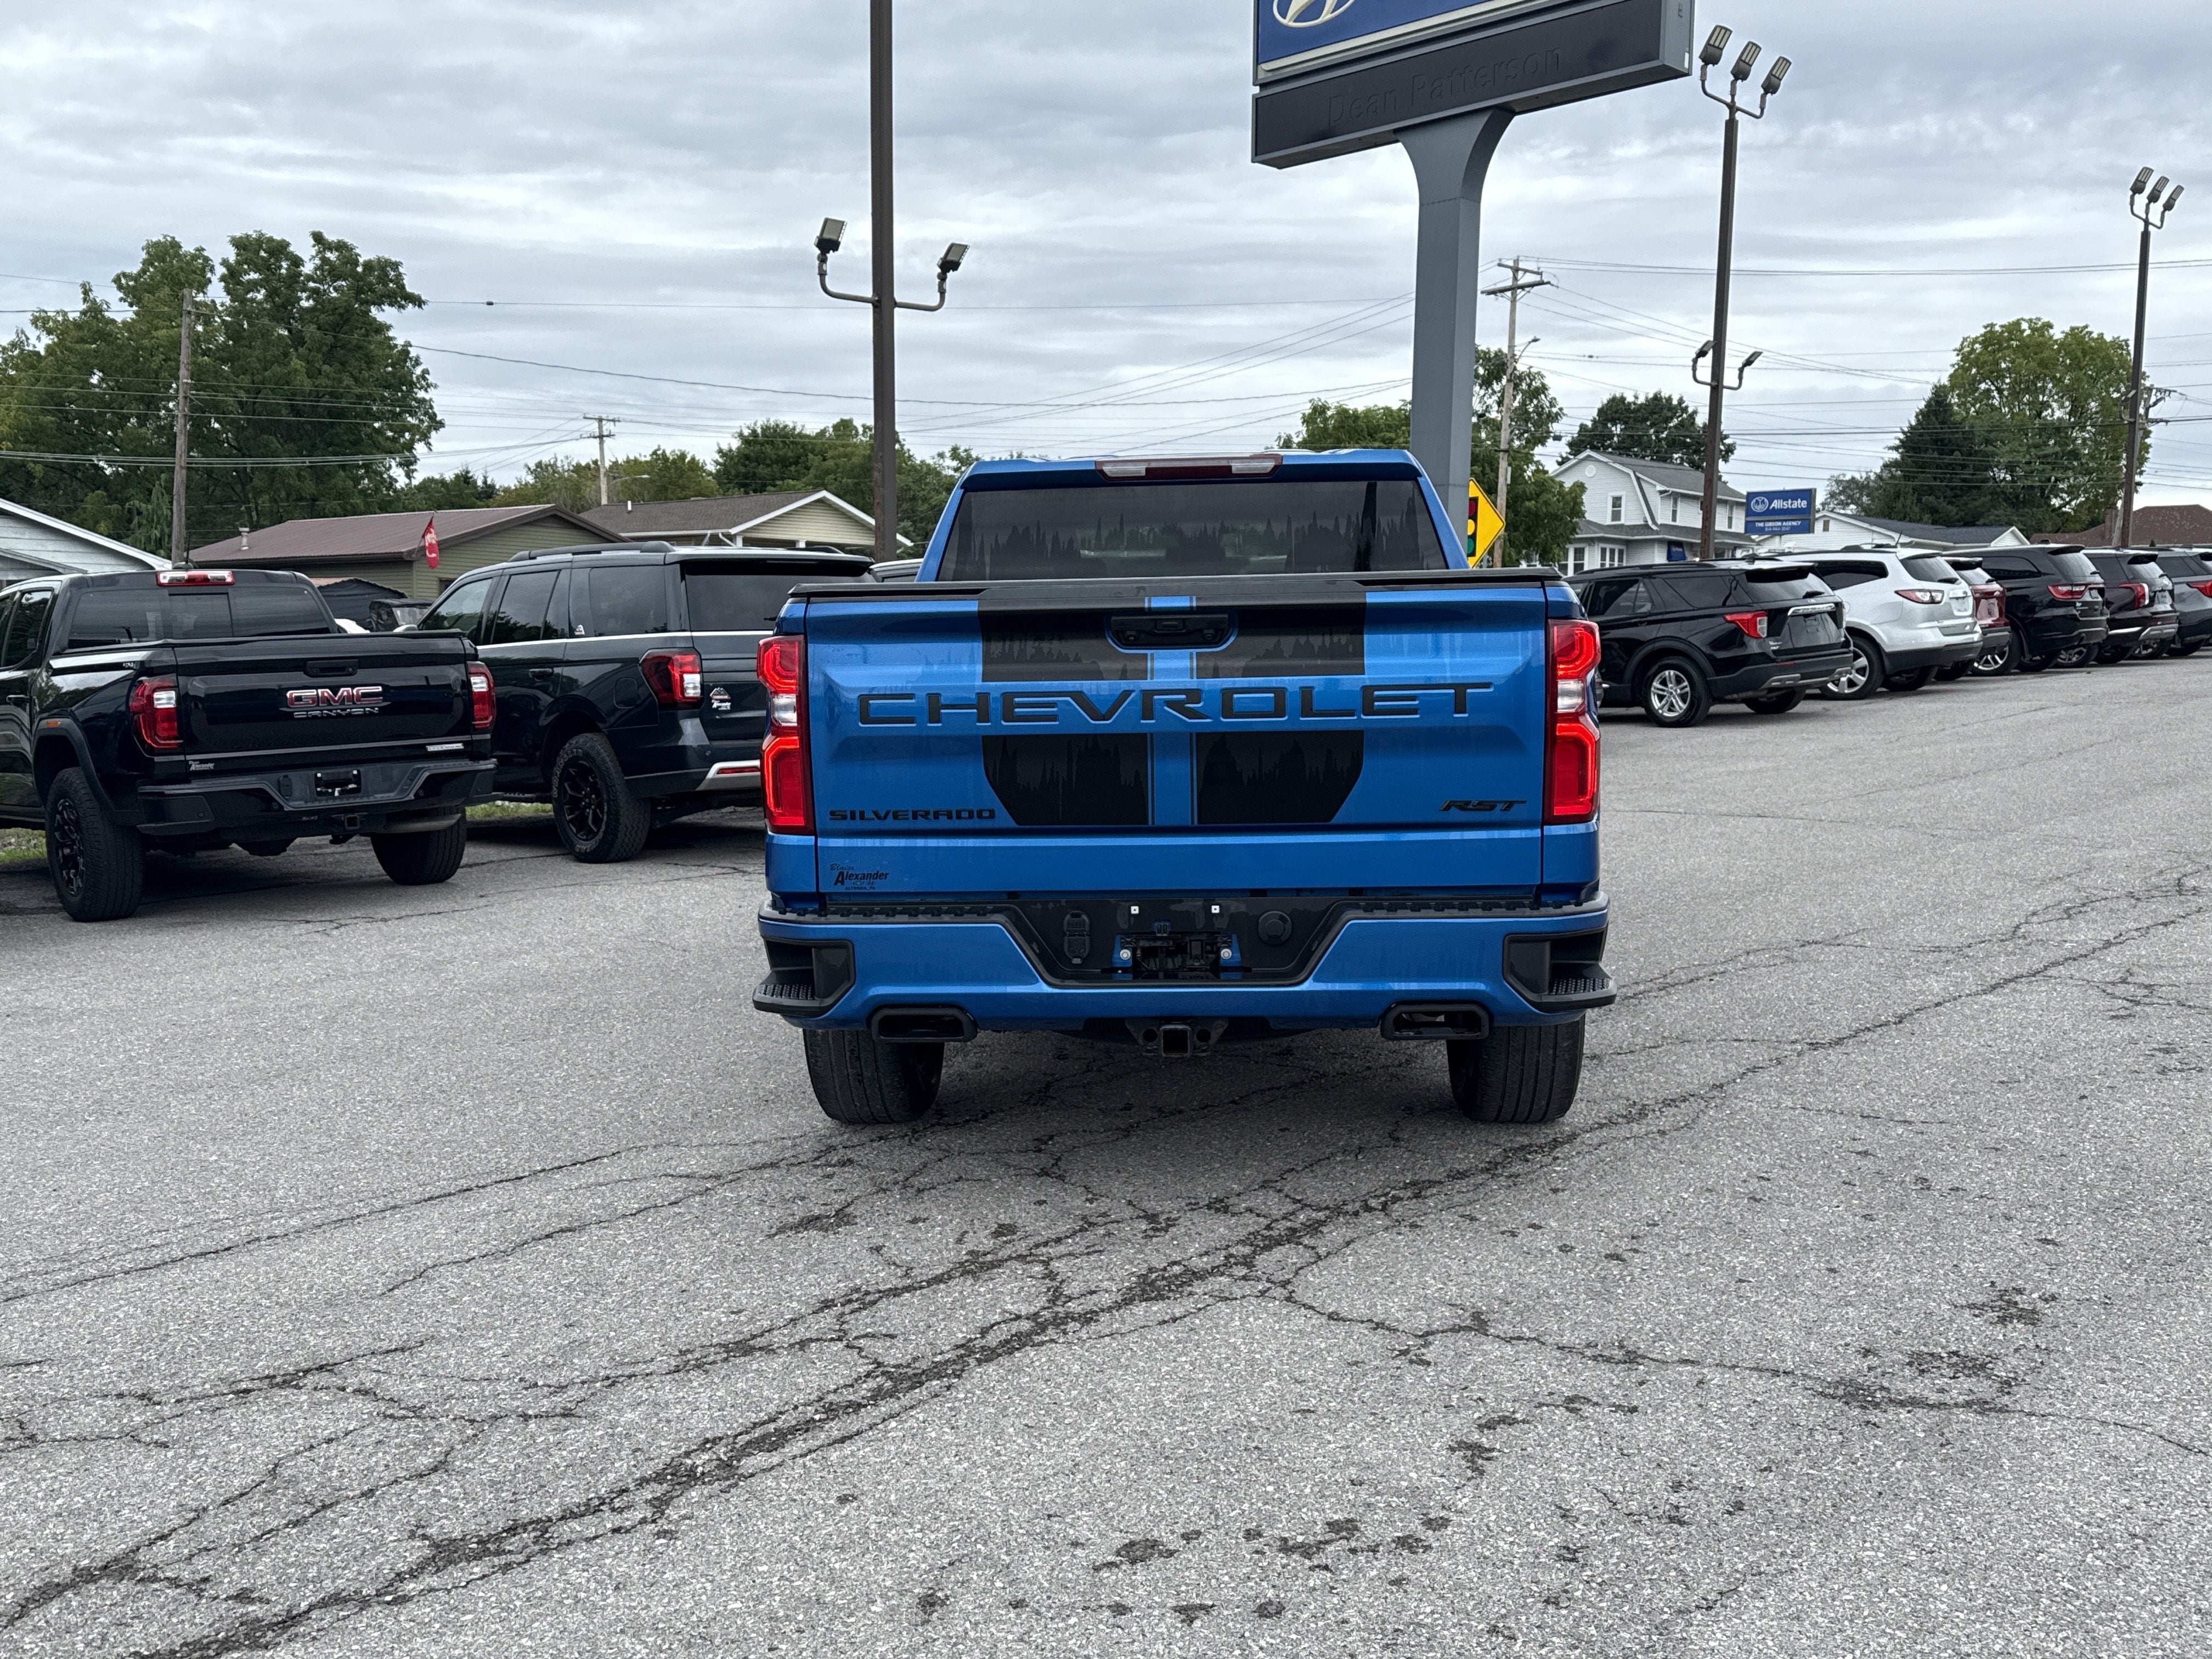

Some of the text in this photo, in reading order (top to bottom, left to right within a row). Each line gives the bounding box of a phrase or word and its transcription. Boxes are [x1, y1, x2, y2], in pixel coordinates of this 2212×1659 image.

[1328, 47, 1562, 127] Dean Patterson
[1769, 498, 1807, 510] Allstate
[286, 686, 383, 708] GMC
[857, 684, 1493, 726] CHEVROLET
[294, 707, 379, 718] CANYON
[1439, 799, 1528, 811] RST
[829, 808, 996, 821] SILVERADO
[830, 863, 855, 871] Blaise
[833, 871, 890, 885] Alexander
